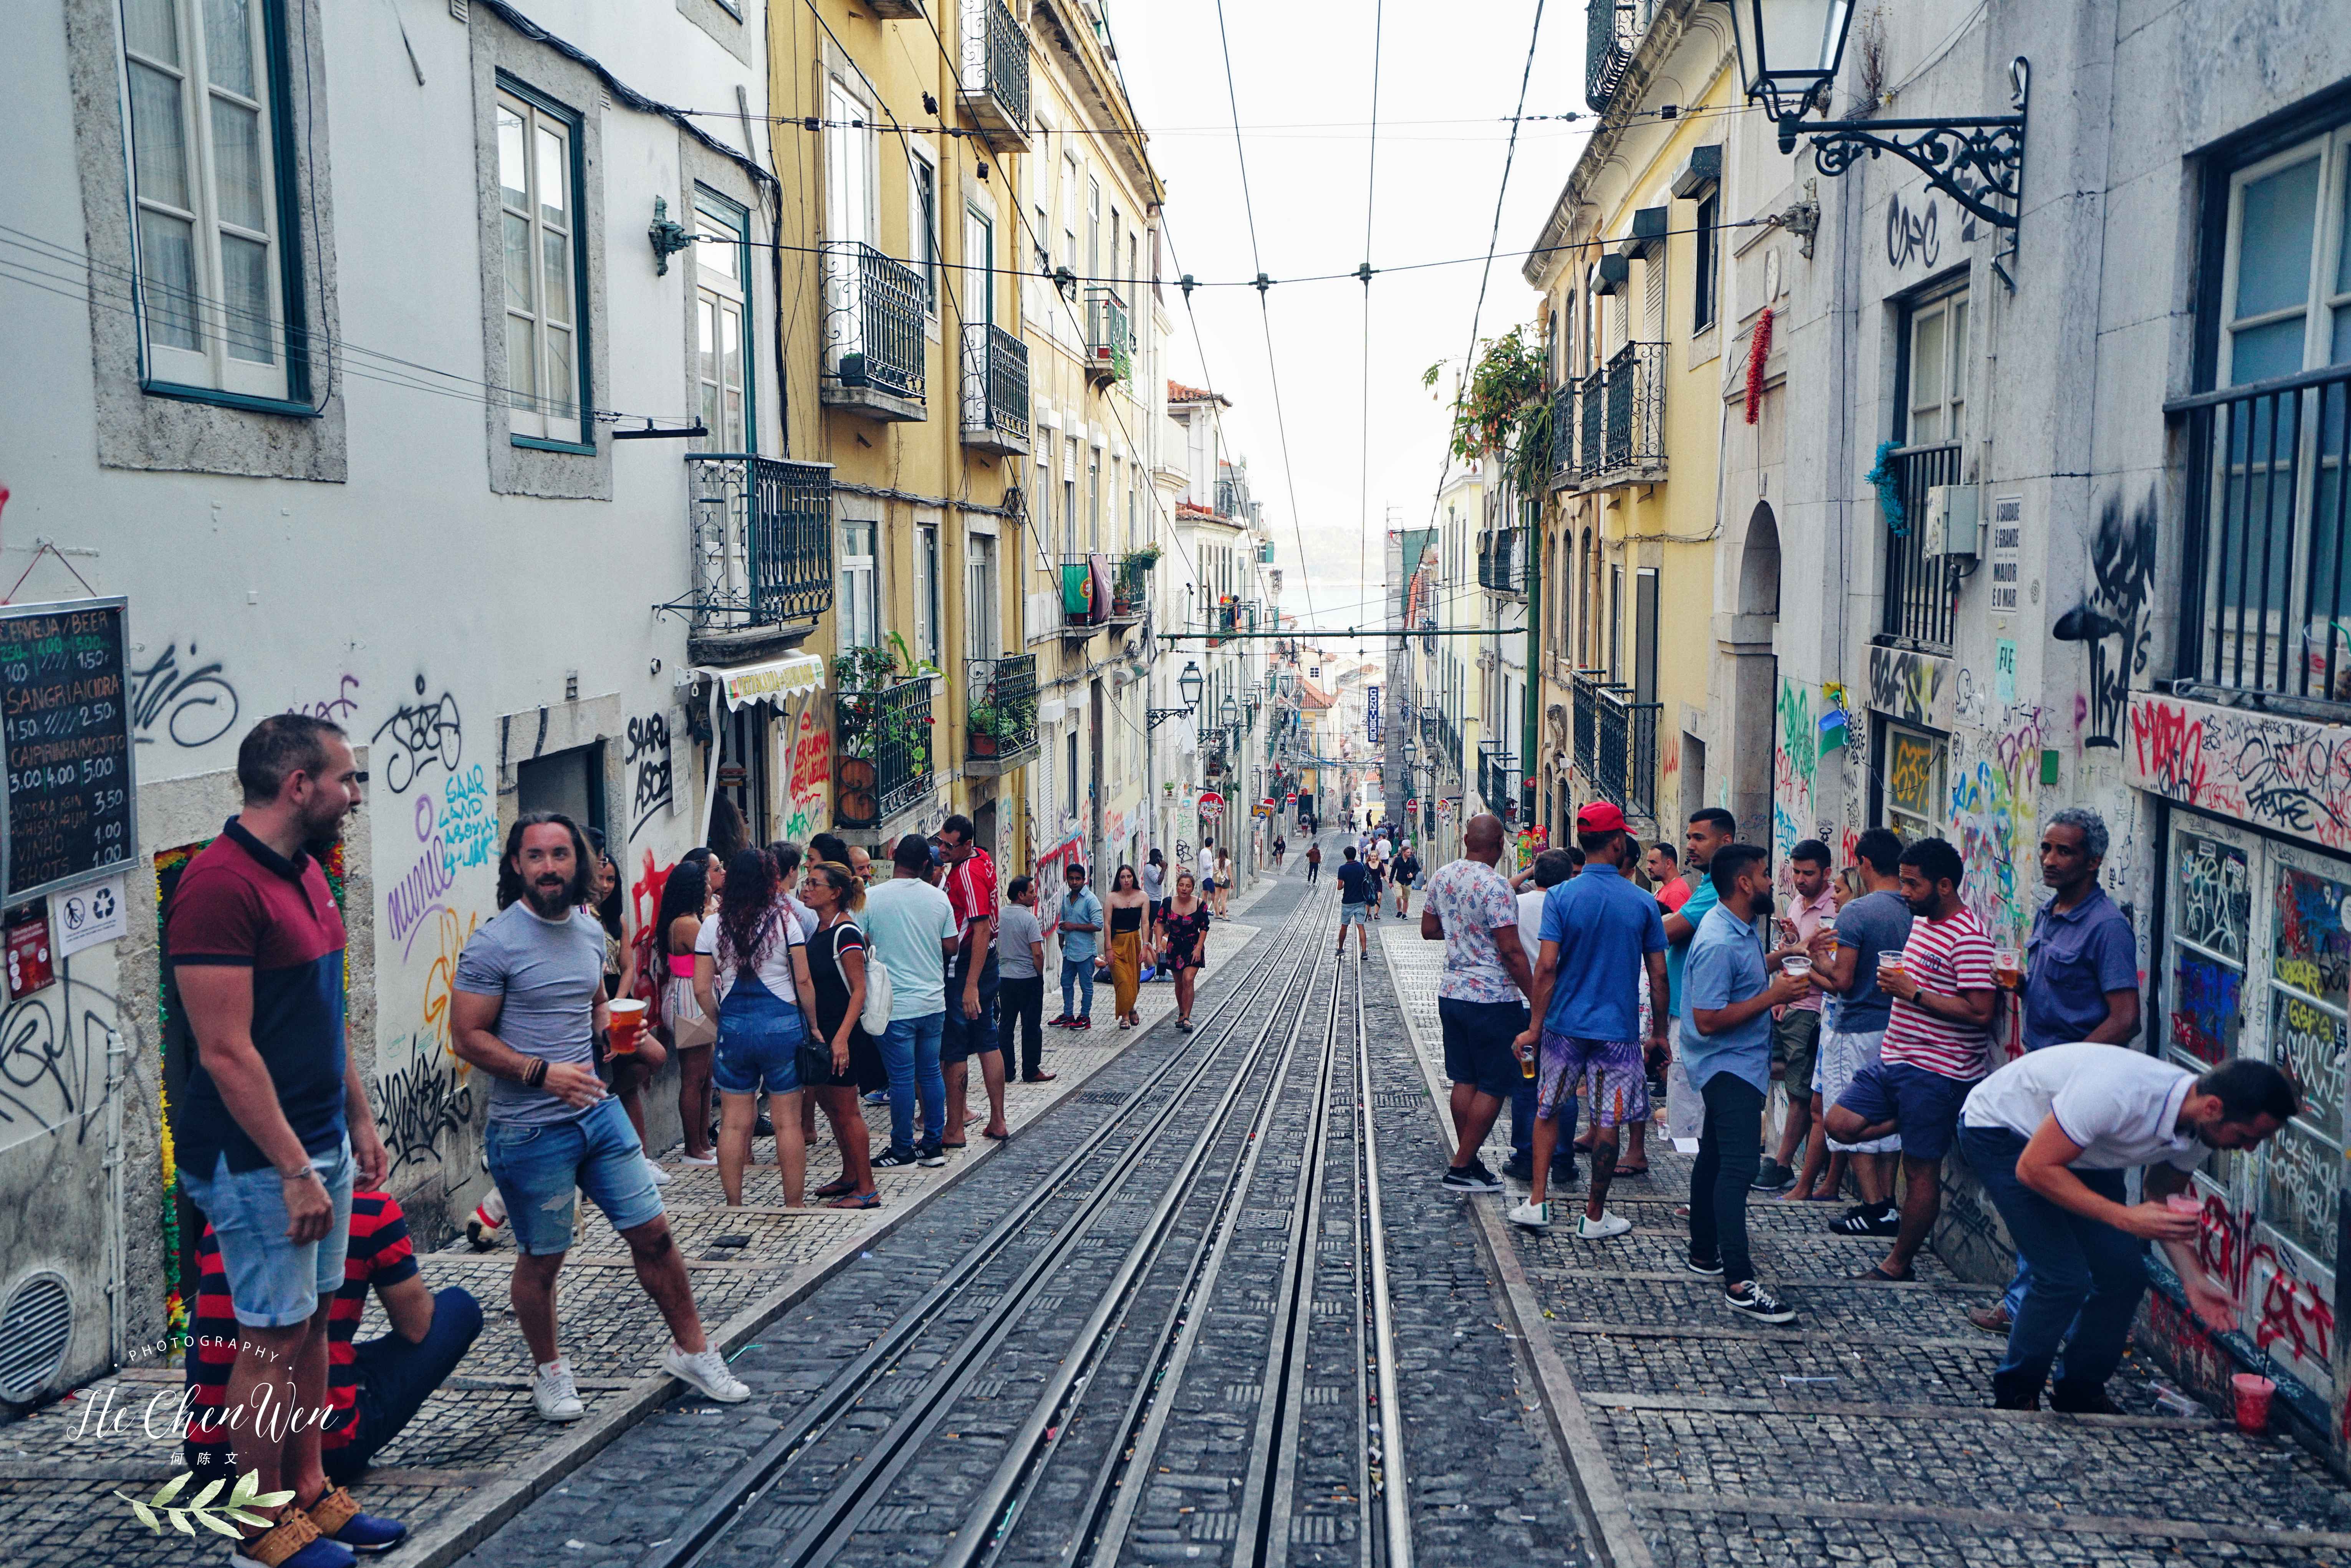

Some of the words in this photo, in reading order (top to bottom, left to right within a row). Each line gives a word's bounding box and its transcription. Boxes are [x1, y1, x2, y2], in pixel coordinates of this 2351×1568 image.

[2000, 502, 2020, 522] SAUDADE
[1999, 528, 2018, 548] GRANDE
[1994, 563, 2017, 582] MAIOR
[1993, 585, 1996, 607] É
[1997, 588, 2001, 607] O
[2003, 588, 2016, 607] MAR
[445, 763, 488, 804] SAAR
[439, 797, 482, 829] LAND
